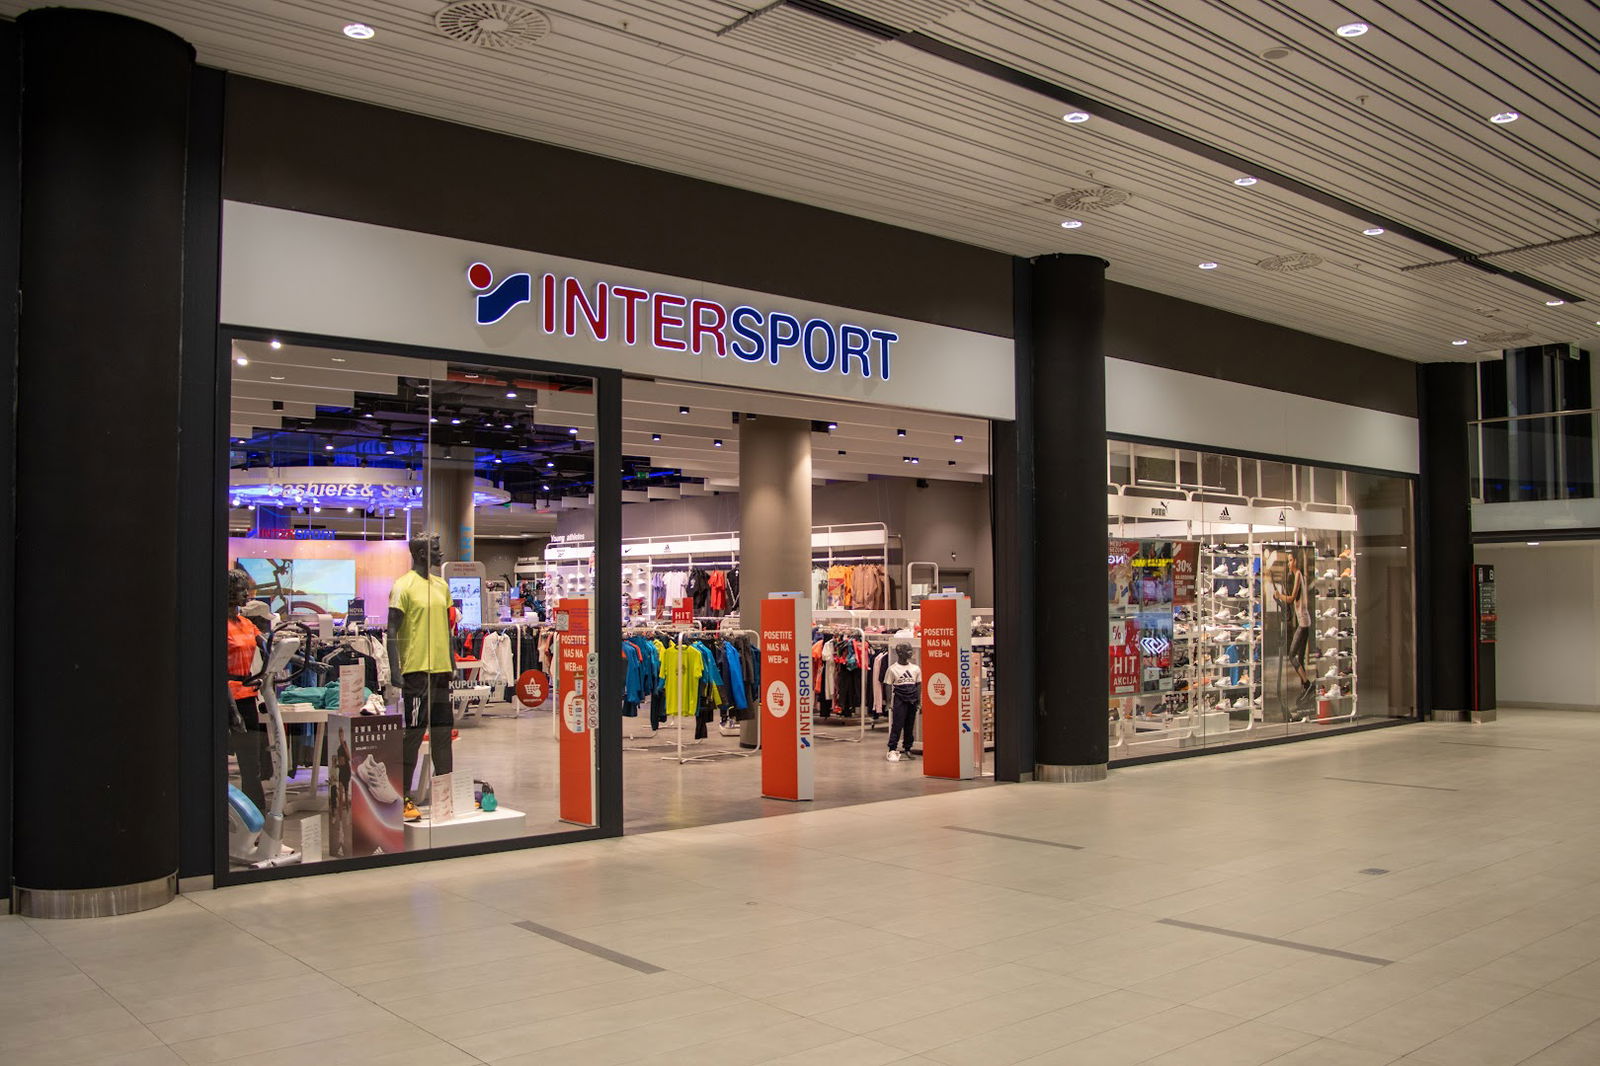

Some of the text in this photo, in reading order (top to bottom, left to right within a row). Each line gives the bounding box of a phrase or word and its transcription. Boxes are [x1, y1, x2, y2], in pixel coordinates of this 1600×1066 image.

[543, 273, 898, 381] INTERSPORT
[267, 482, 357, 498] Cashiers
[360, 483, 373, 497] &
[675, 612, 691, 620] HIT
[764, 630, 792, 640] POSETITE
[923, 628, 954, 636] POSETITE
[561, 635, 586, 645] POSETITE
[927, 639, 951, 647] NAS NA
[767, 642, 790, 652] NAS NA
[564, 648, 584, 658] NAS NA
[928, 650, 950, 658] WEB-u
[768, 654, 789, 664] WEB-u
[1114, 656, 1137, 674] HIT
[961, 647, 971, 722] INTERSPORT
[1113, 676, 1137, 686] AKCIJA
[799, 653, 810, 735] INTERSPORT
[355, 723, 398, 734] OWN YOUR
[355, 733, 386, 743] ENERGY
